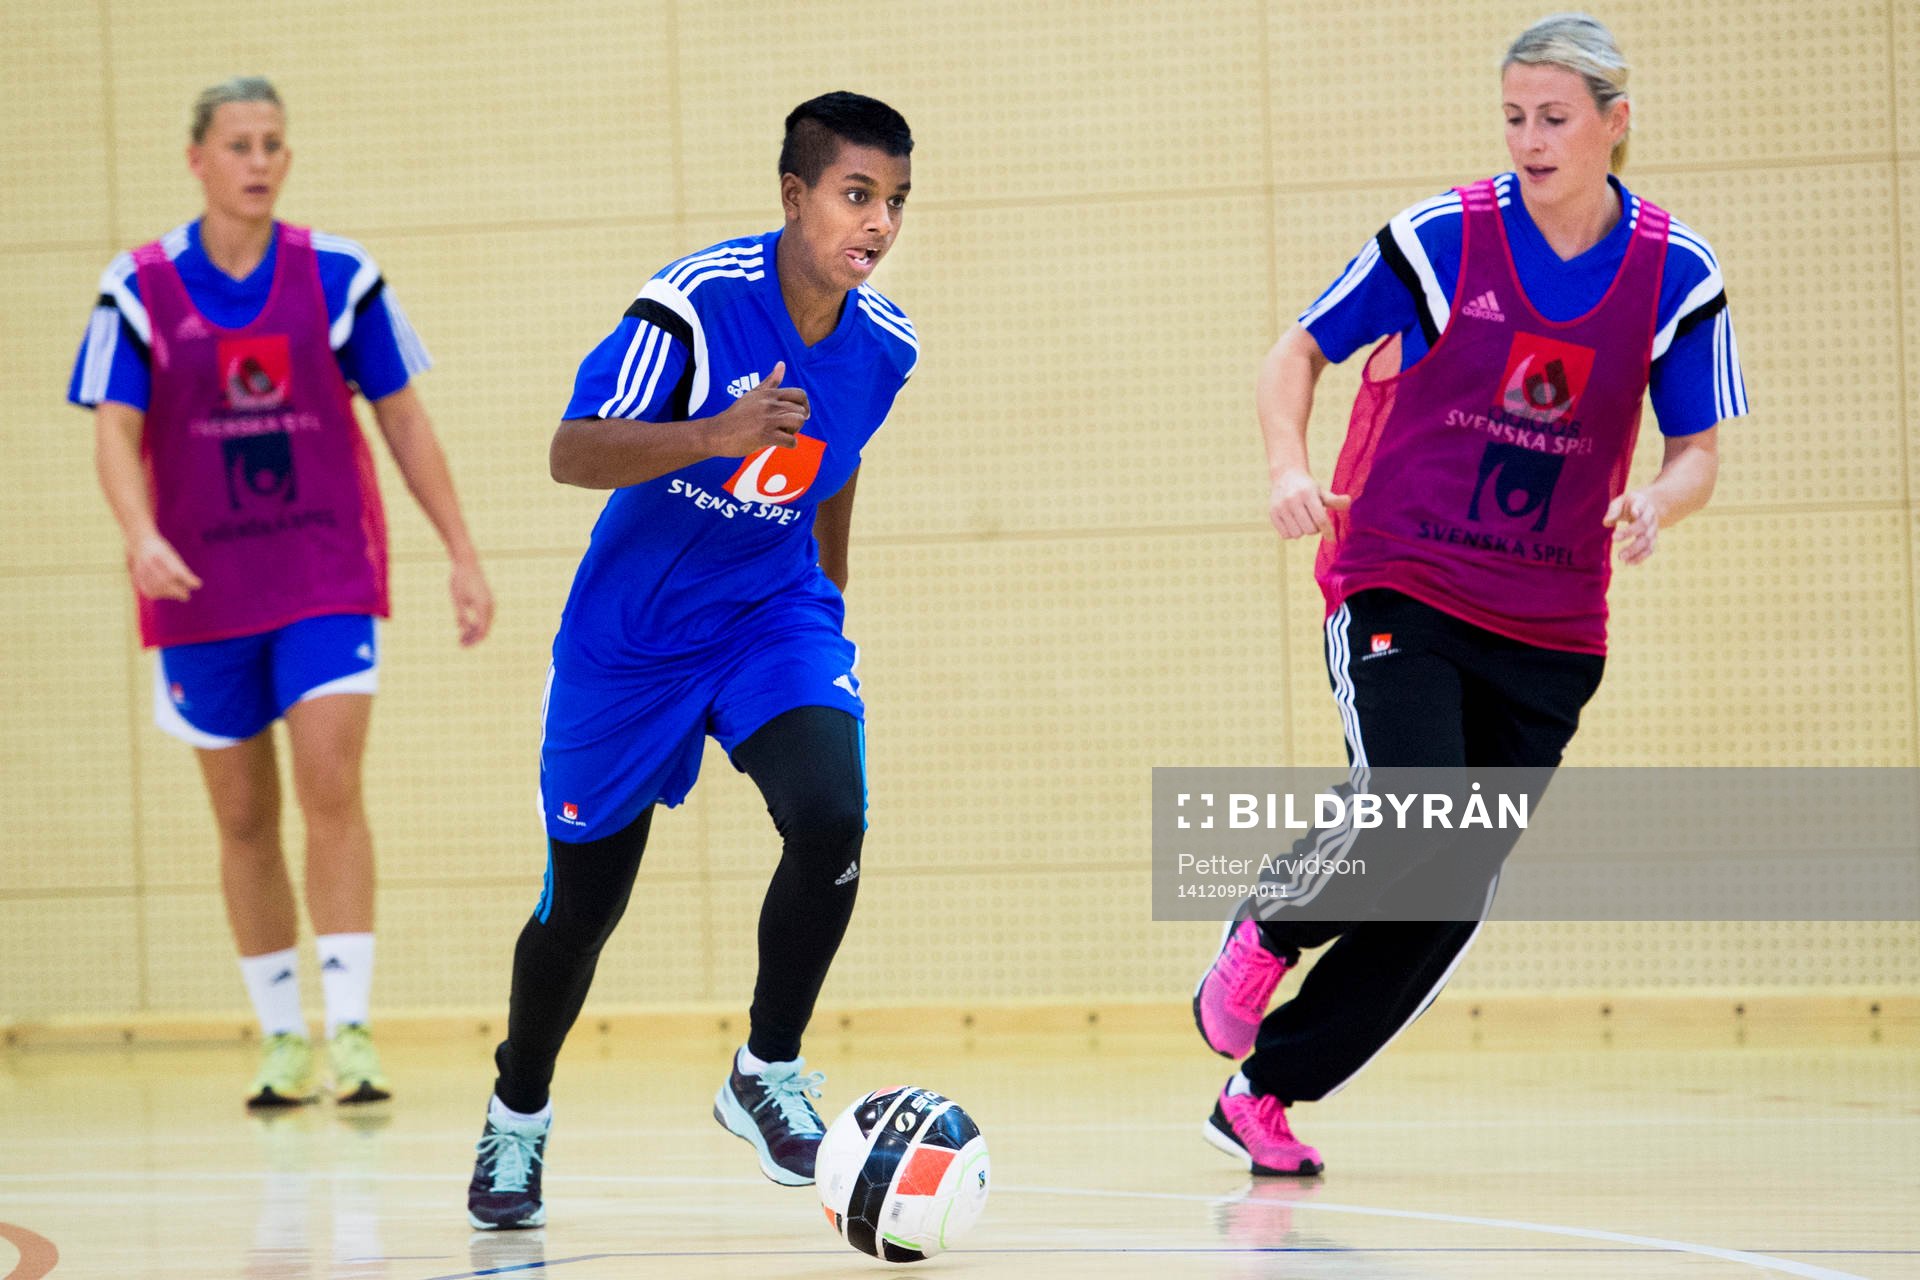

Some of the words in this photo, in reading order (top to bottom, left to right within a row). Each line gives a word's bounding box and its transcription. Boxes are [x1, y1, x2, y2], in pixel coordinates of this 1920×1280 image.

[1461, 305, 1505, 322] adidas
[1445, 408, 1547, 452] SVENSKA
[1417, 520, 1526, 559] SVENSKA
[1531, 543, 1576, 566] SPEL
